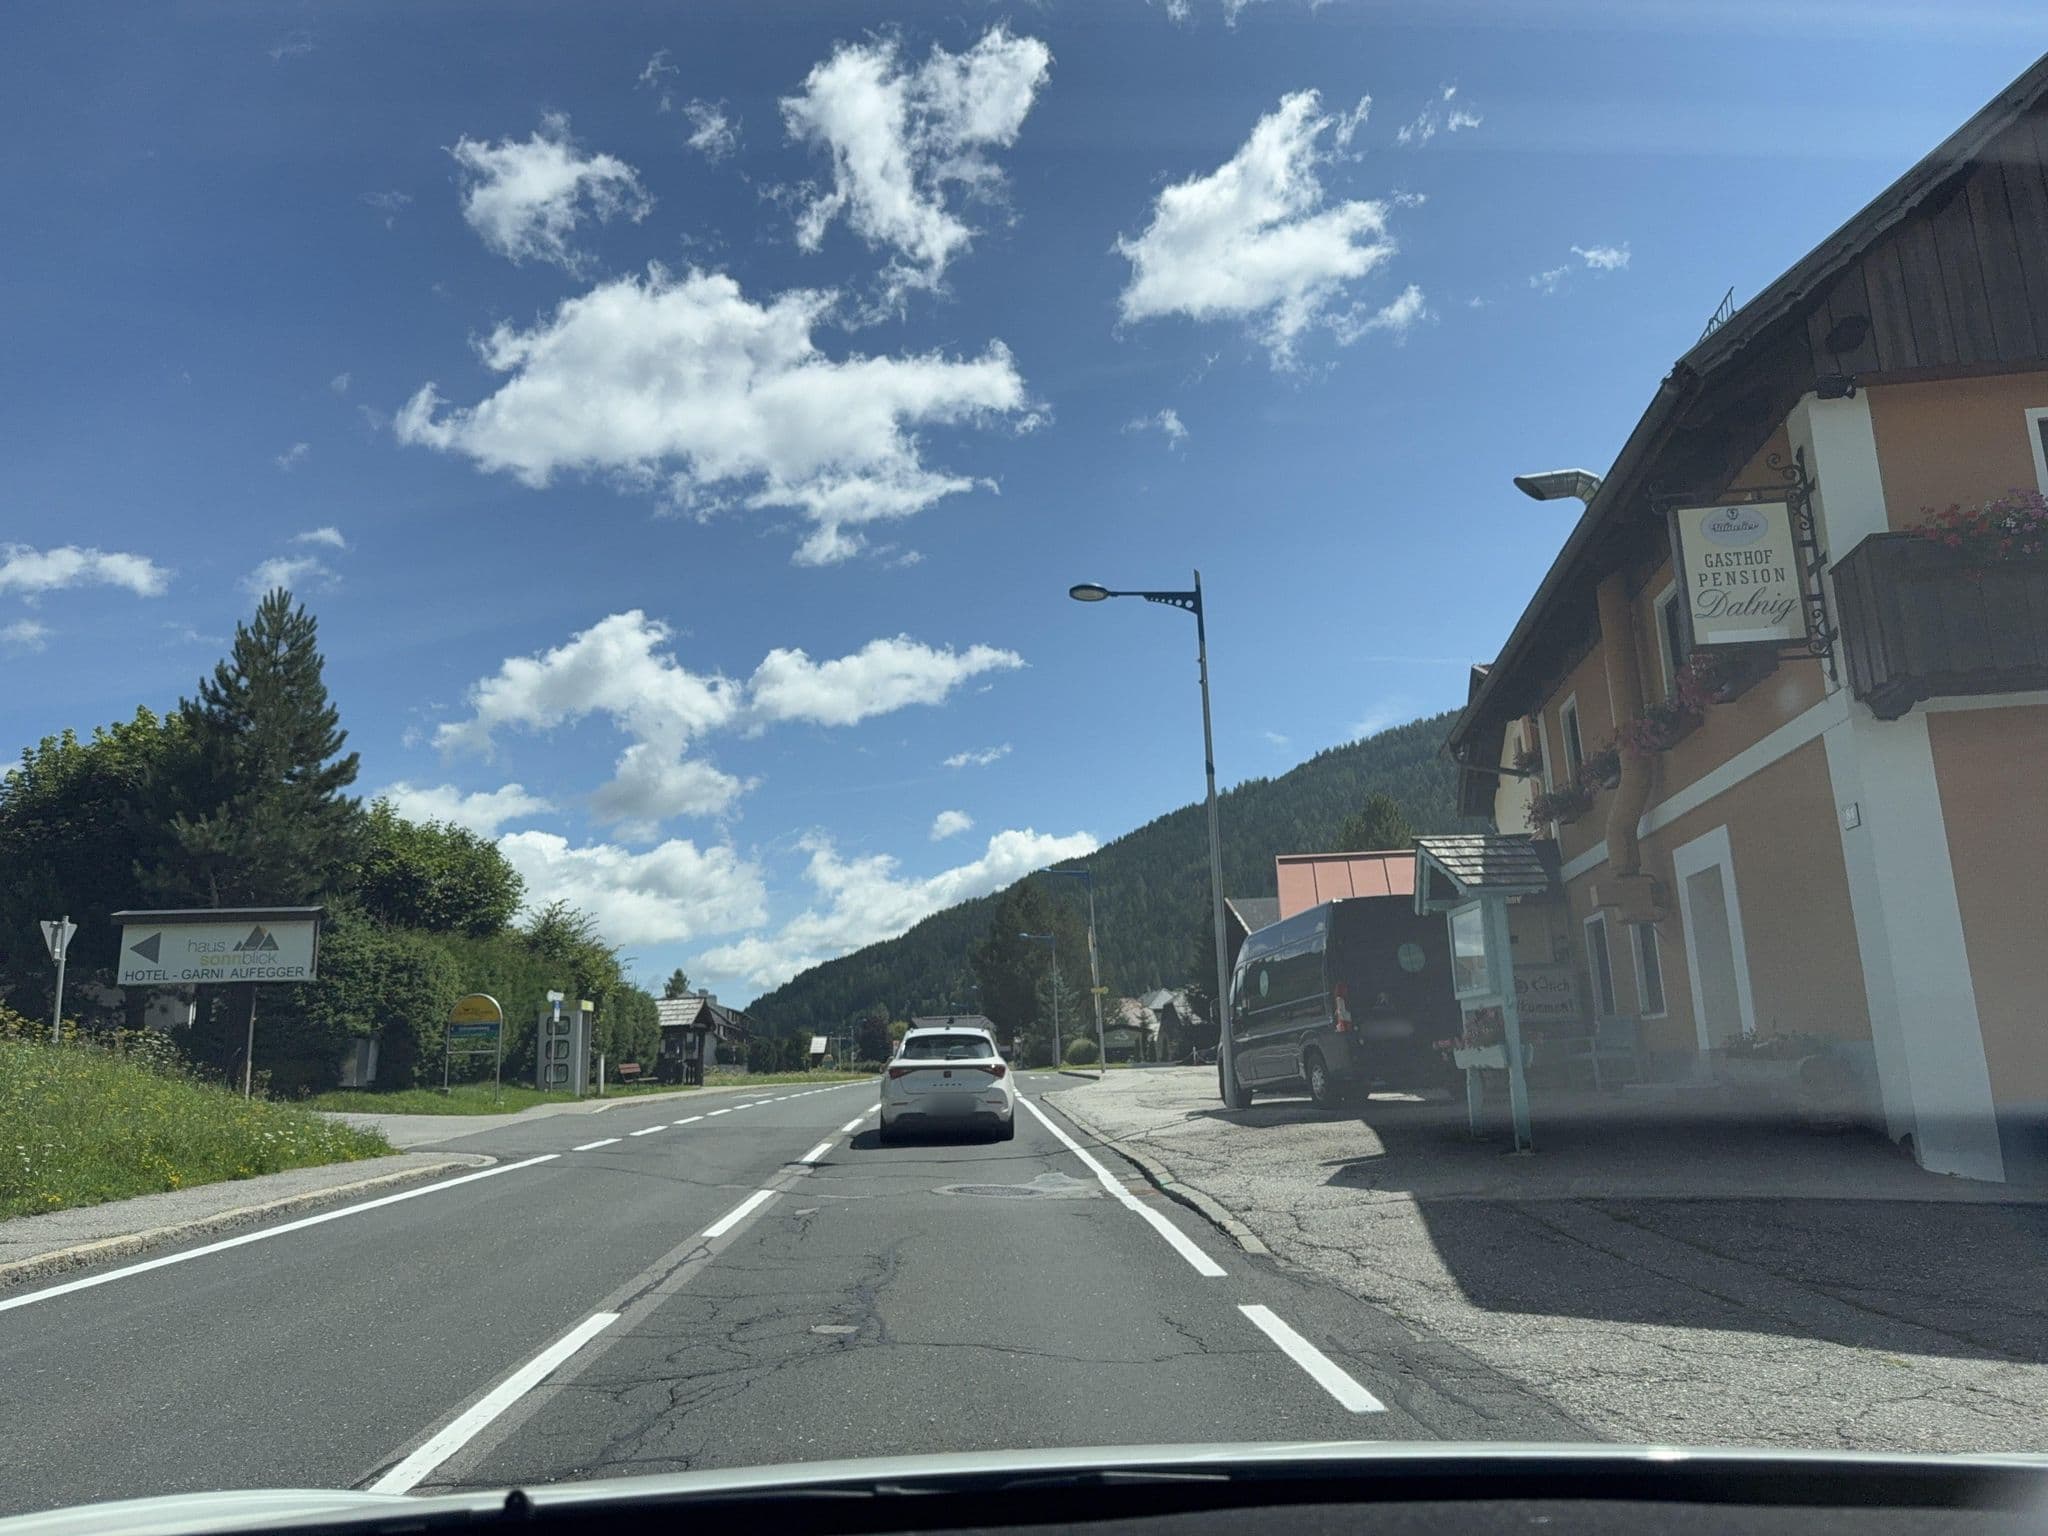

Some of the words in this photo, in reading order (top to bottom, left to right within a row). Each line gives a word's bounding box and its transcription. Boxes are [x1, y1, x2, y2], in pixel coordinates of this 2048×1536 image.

[1704, 549, 1773, 568] GASTHOF
[1698, 567, 1785, 587] PENSION
[187, 938, 226, 953] haus
[124, 969, 169, 982] HOTEL
[181, 968, 224, 980] GARNI
[230, 966, 305, 979] AUFEGGER
